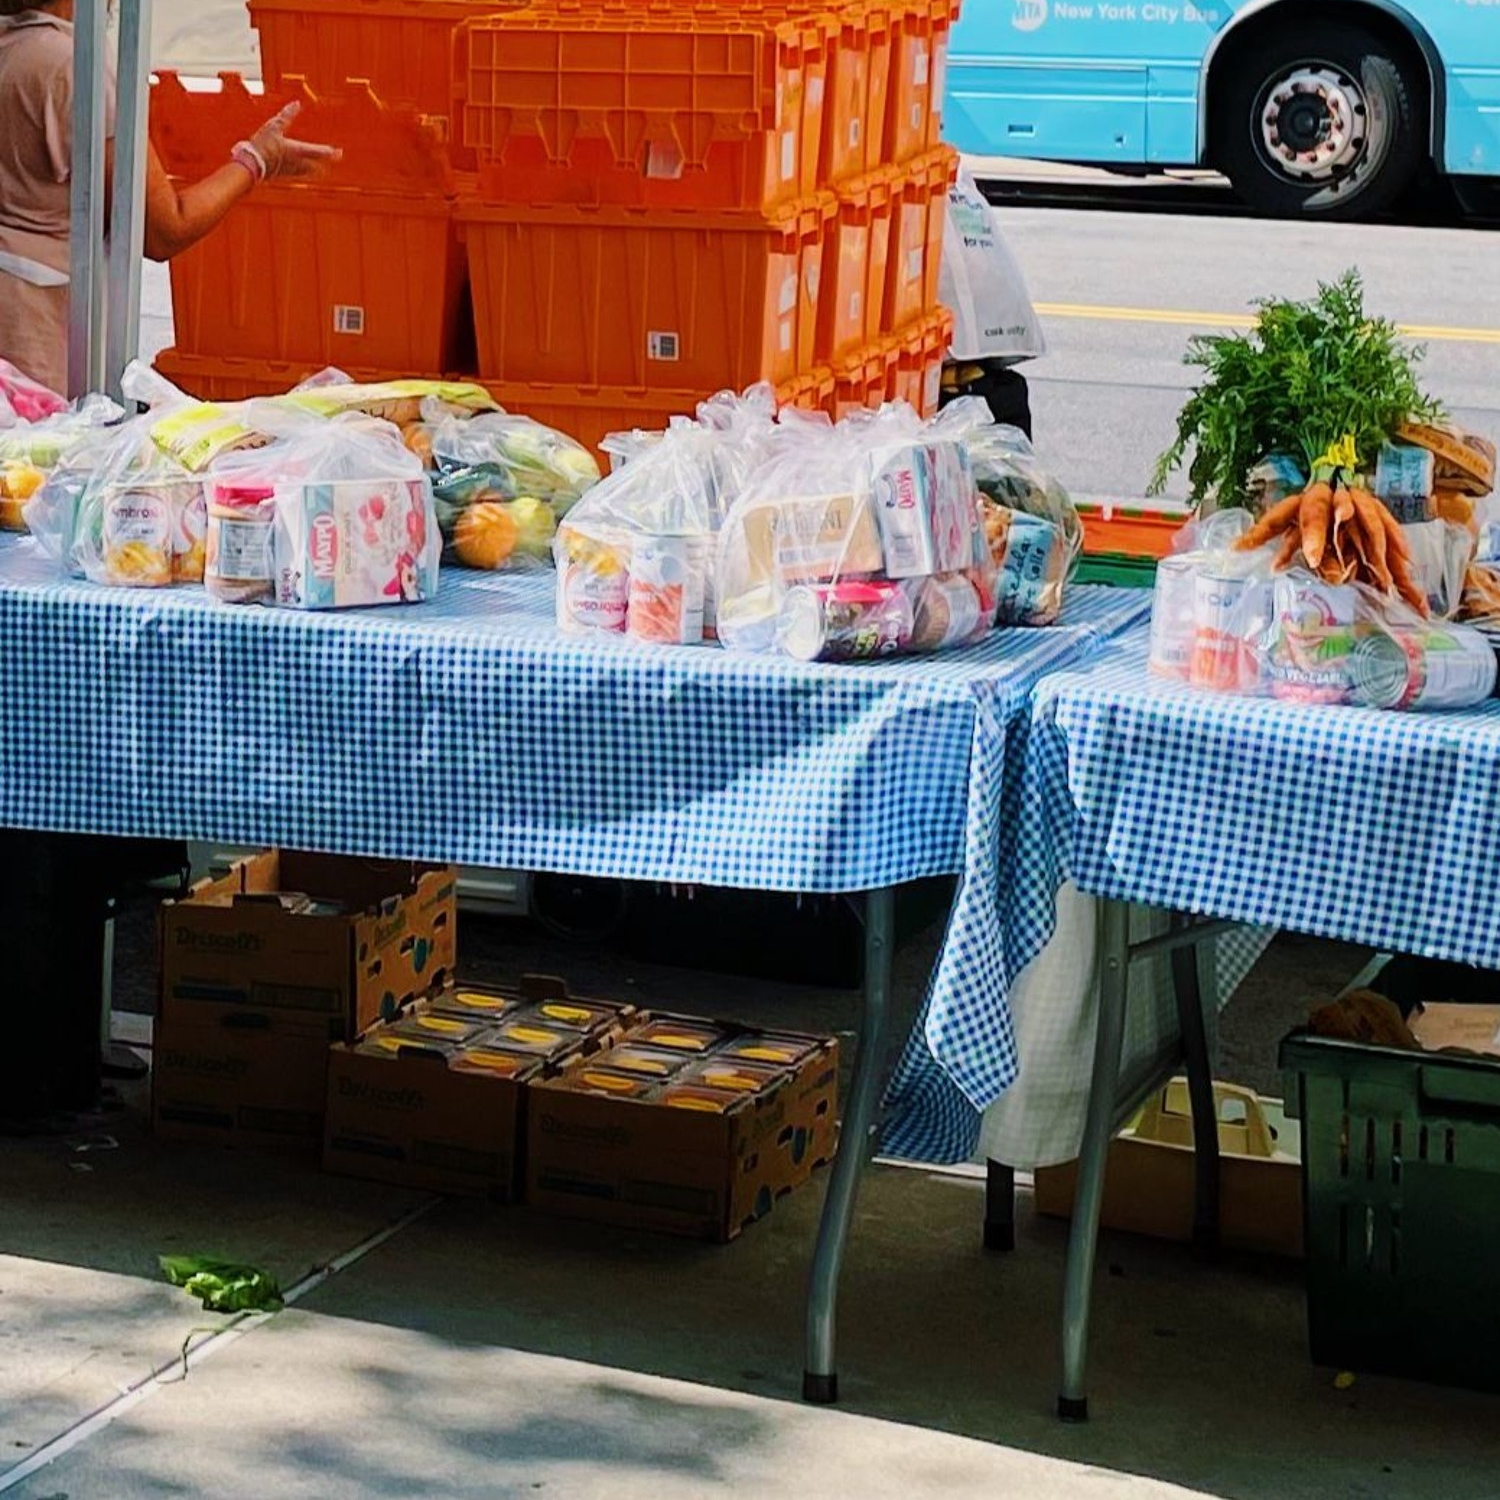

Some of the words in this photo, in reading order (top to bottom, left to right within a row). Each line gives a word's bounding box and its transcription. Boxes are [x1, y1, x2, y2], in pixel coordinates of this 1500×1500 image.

[1054, 2, 1093, 19] New
[1098, 2, 1137, 20] York
[1141, 2, 1178, 23] City
[1183, 4, 1219, 22] Bus
[312, 513, 336, 580] MAYPO
